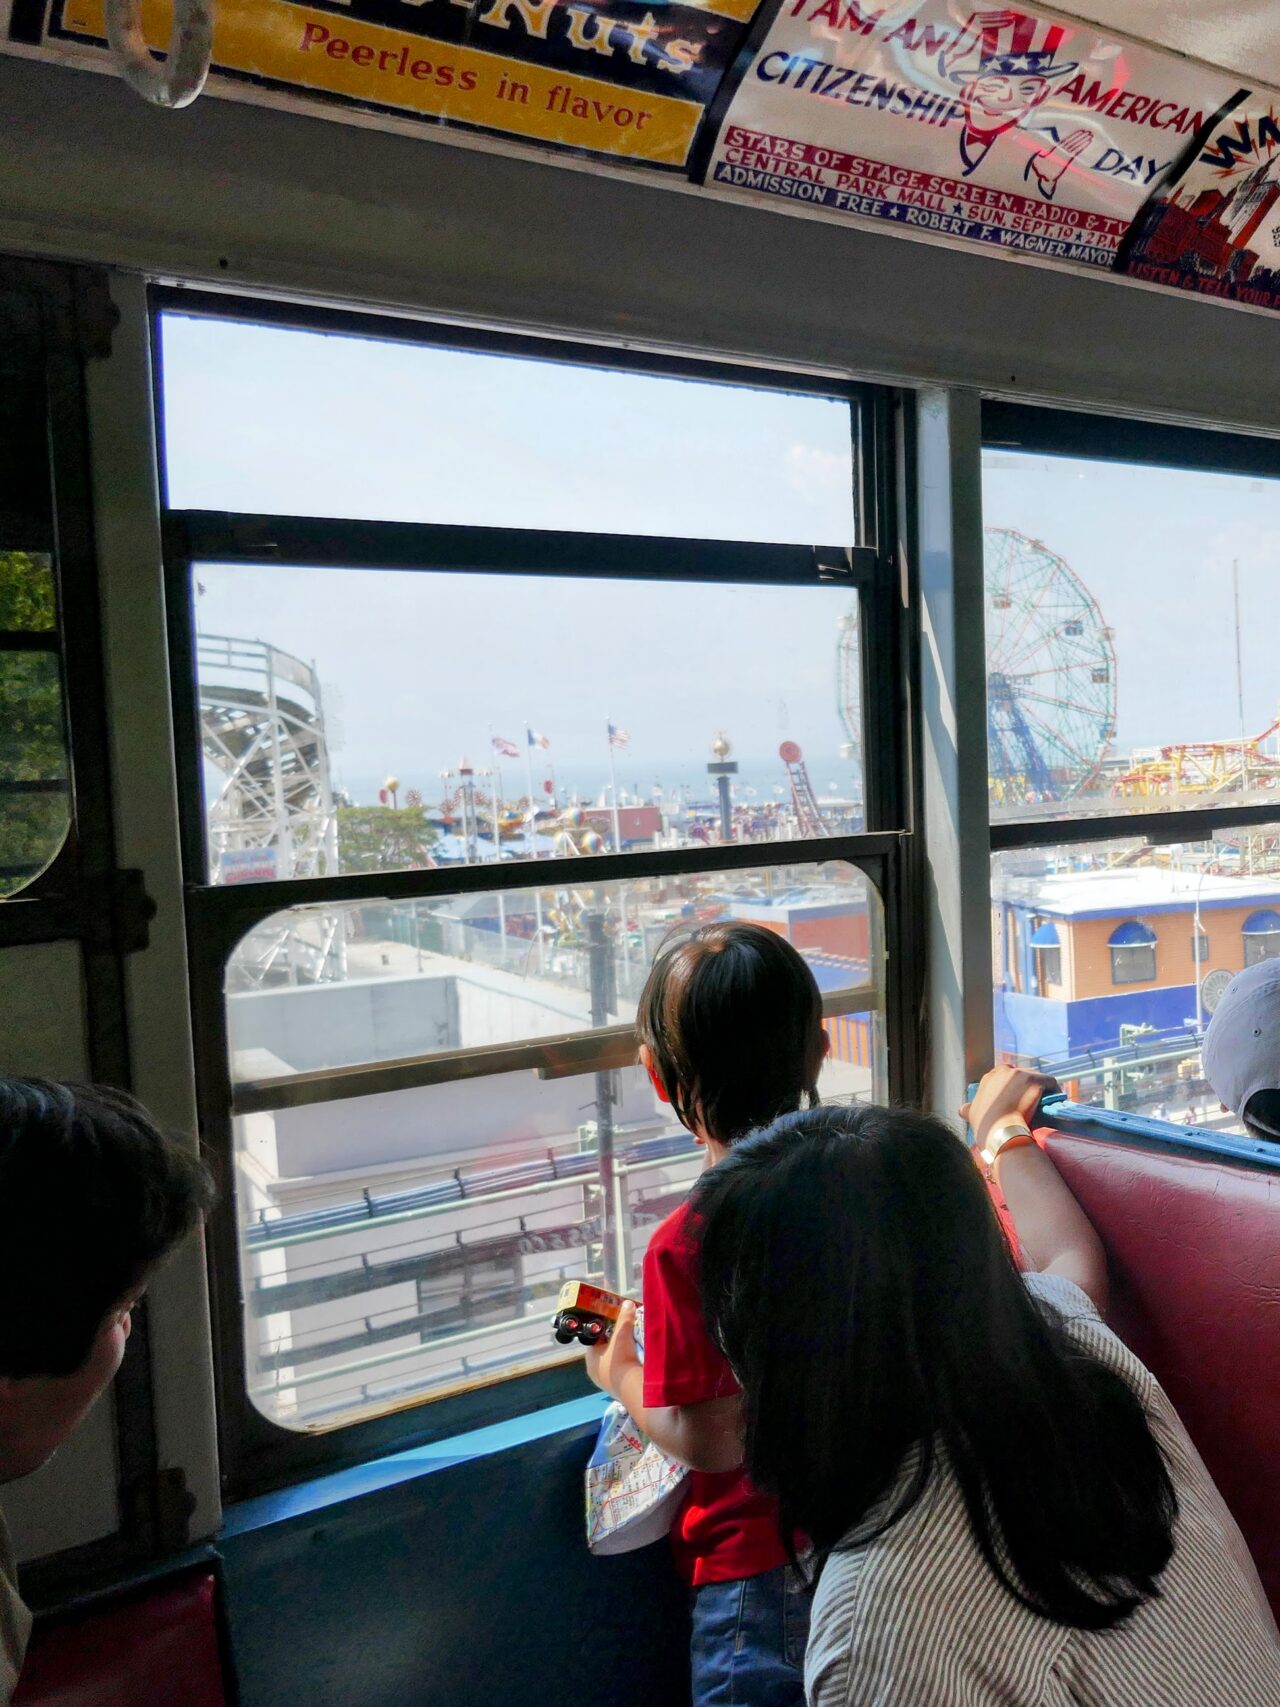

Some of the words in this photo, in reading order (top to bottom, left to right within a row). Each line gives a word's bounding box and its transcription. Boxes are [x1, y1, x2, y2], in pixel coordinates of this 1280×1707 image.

[299, 22, 478, 92] Peerless
[496, 73, 529, 104] in
[546, 85, 653, 130] flavor
[756, 51, 965, 127] CITIZENSHIP
[1091, 148, 1172, 184] DAY
[881, 19, 950, 56] AN
[1053, 74, 1203, 137] AMERICAN
[717, 165, 828, 201] ADMISSION
[835, 191, 886, 216] FREE
[905, 208, 976, 235] ROBERT
[981, 226, 993, 241] F.
[725, 148, 825, 185] CENTRAL
[835, 173, 893, 200] PARK
[897, 187, 947, 212] MALL
[968, 206, 1007, 227] SUN.
[1057, 224, 1075, 241] 19
[729, 129, 806, 160] STARS
[815, 150, 844, 168] OF
[850, 158, 924, 189] STAGE,
[1023, 202, 1080, 226] RADIO
[1085, 215, 1099, 229] &
[1103, 219, 1131, 235] TV
[1127, 259, 1180, 287] LISTEN
[1198, 277, 1231, 298] TELL
[1235, 284, 1271, 307] YOUR
